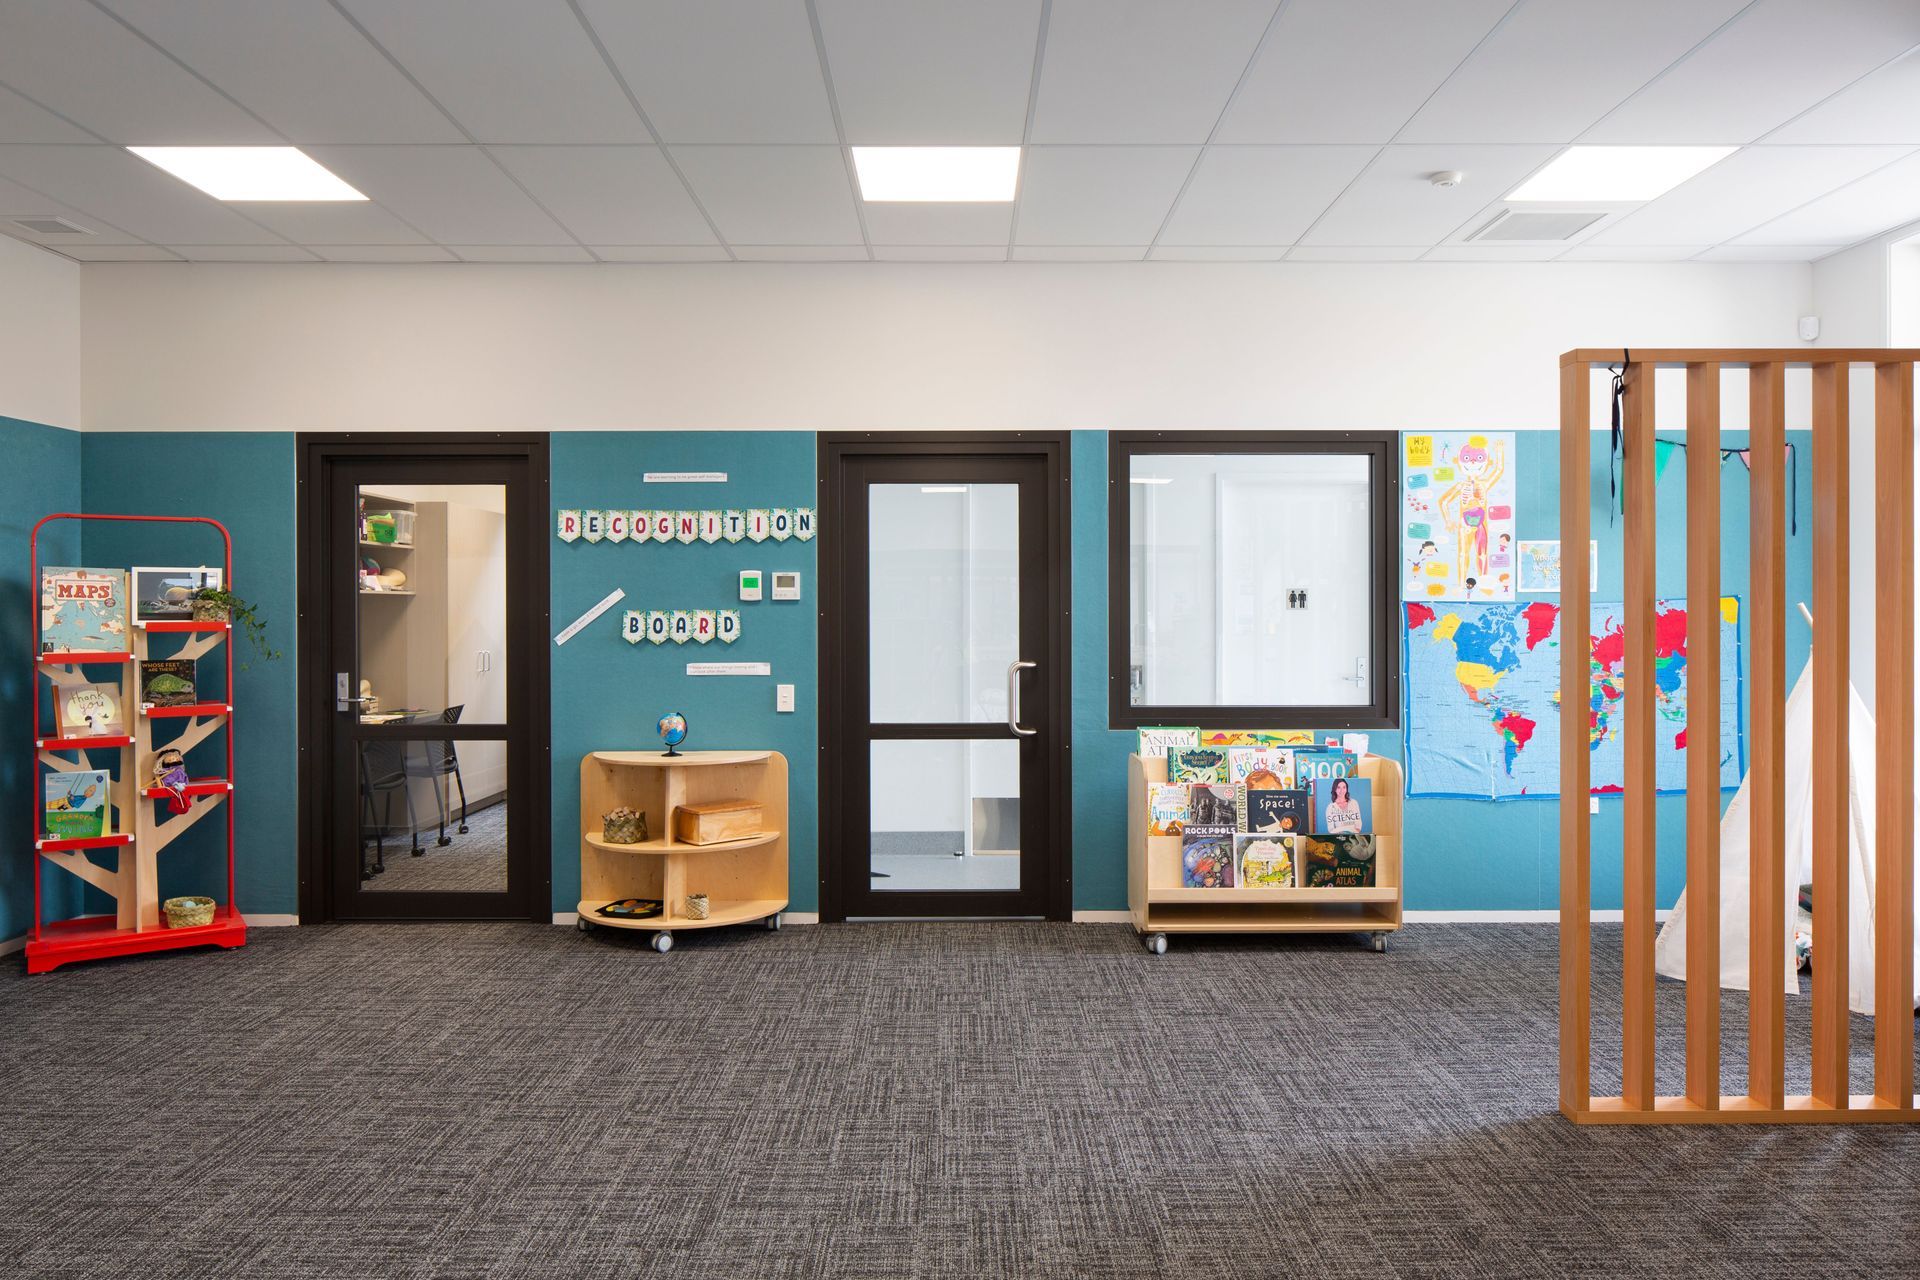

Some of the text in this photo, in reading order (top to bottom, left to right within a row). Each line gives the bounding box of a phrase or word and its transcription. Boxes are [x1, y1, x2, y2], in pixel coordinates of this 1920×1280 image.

[565, 515, 810, 534] RECOGNITION
[58, 584, 110, 599] MAPS
[629, 616, 734, 634] BOARD
[70, 685, 104, 704] thank
[80, 701, 104, 715] you
[1146, 736, 1194, 746] ANIMAL
[1309, 761, 1346, 779] 100
[1237, 785, 1247, 820] WORLD
[1259, 798, 1295, 811] Space!
[1327, 812, 1361, 824] SCIENCE
[1185, 827, 1236, 835] ROCK POOLS
[1335, 867, 1362, 876] ANIMAL
[1335, 876, 1357, 885] ATLAS
